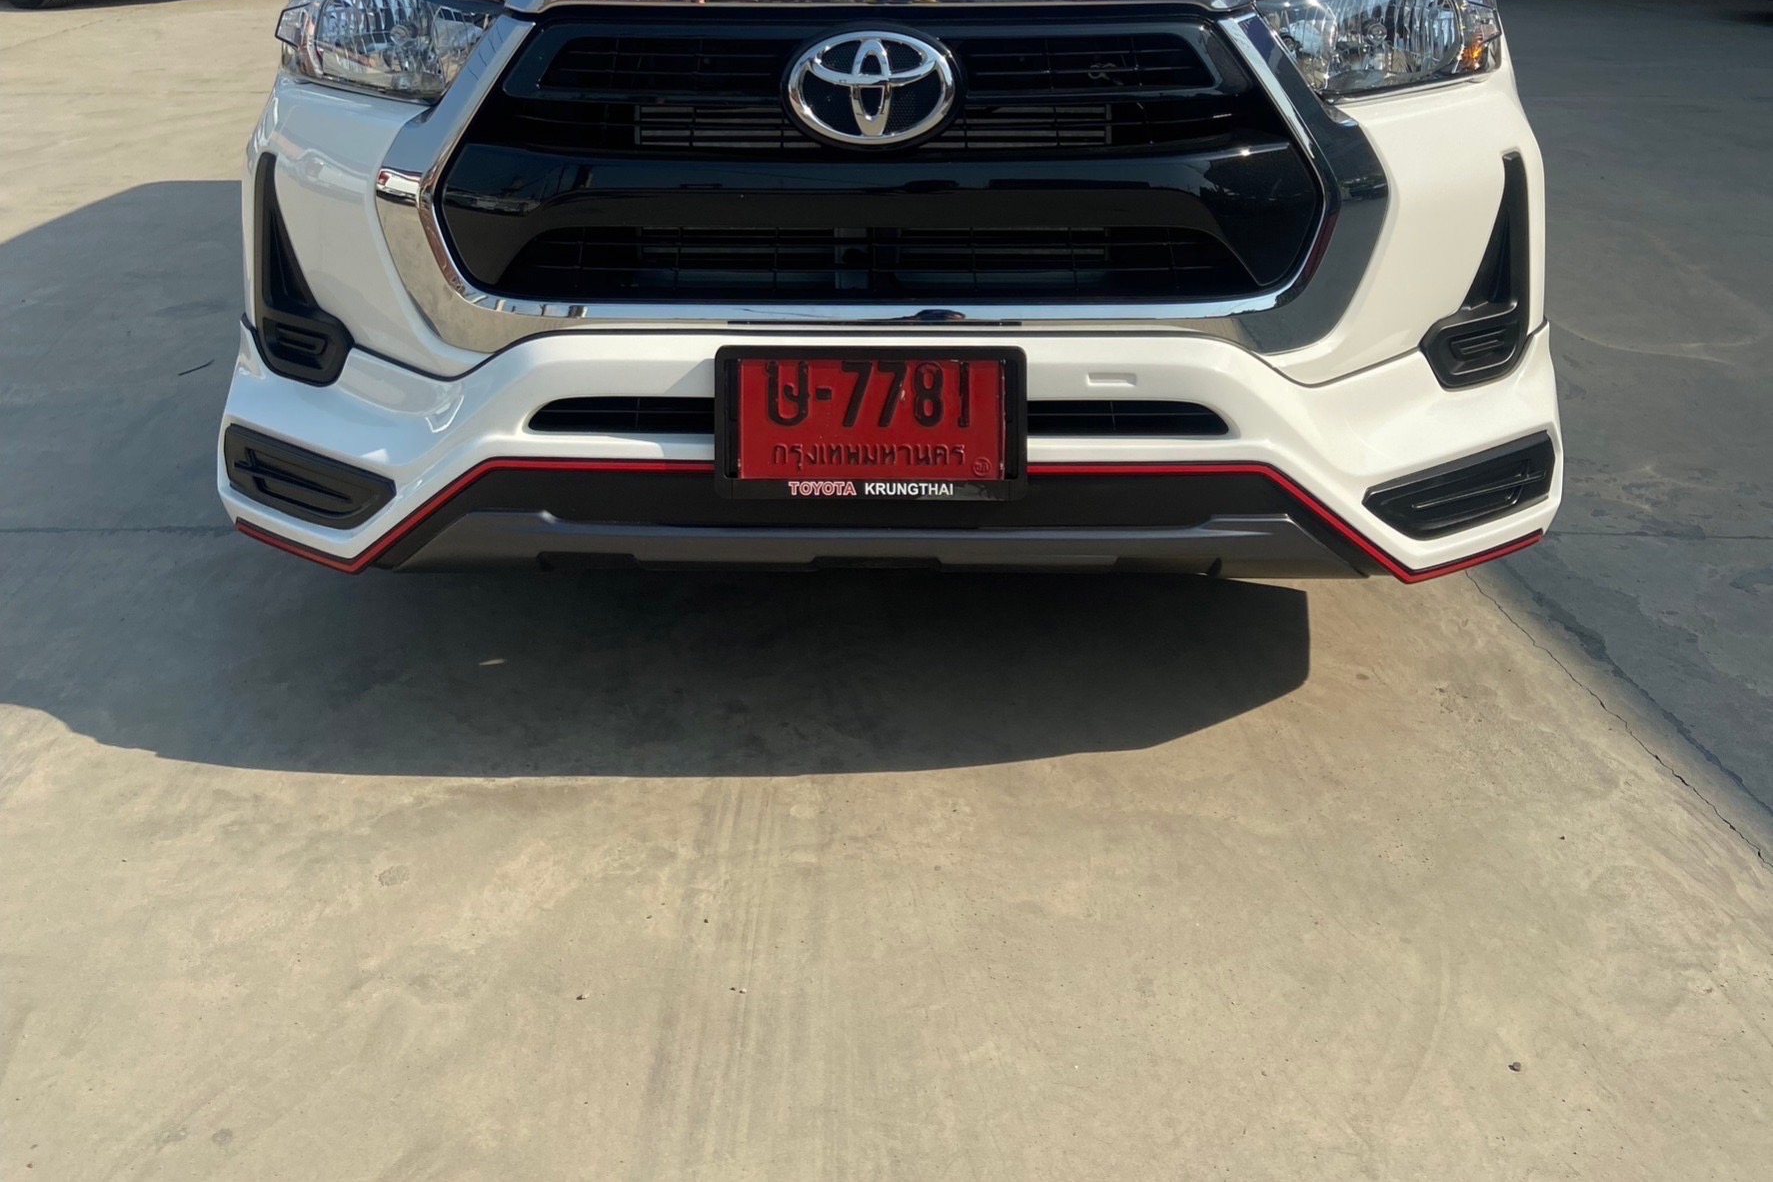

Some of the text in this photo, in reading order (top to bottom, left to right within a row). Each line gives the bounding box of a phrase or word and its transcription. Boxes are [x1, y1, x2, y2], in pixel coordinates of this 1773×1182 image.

[773, 443, 965, 471] กรุงเทพมหานคร
[788, 481, 954, 497] TOYOTA KRUNGTHAI
